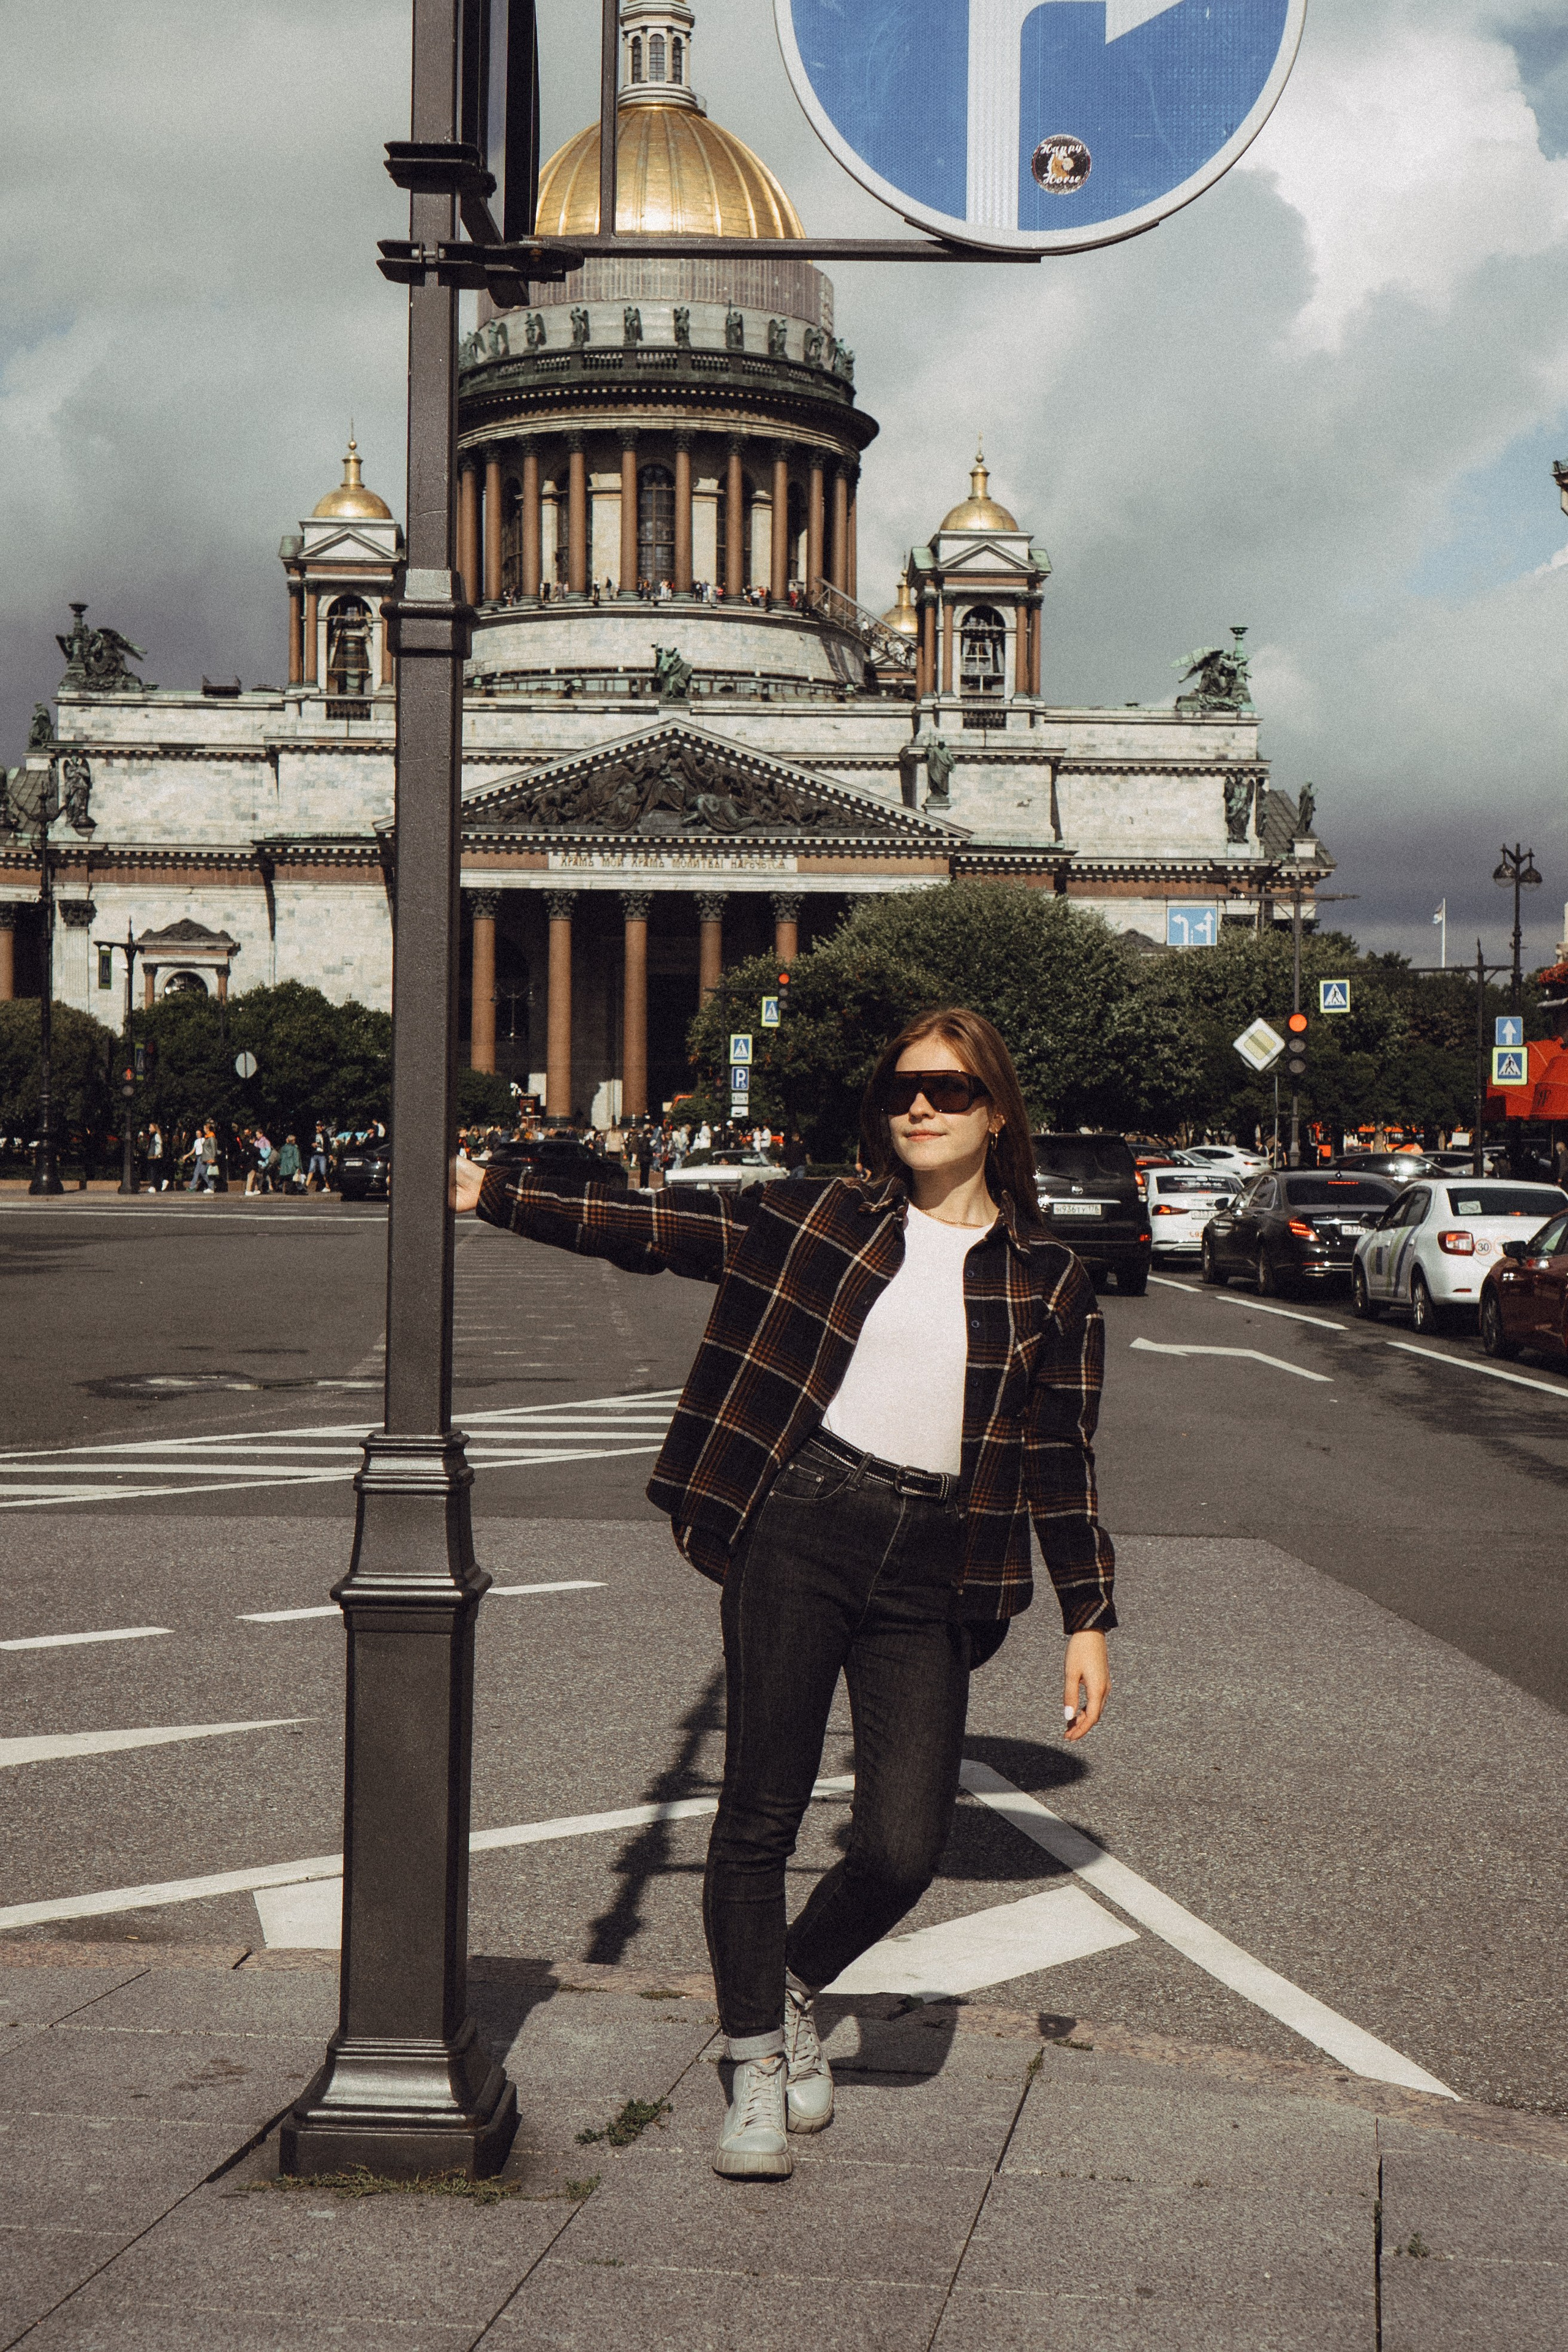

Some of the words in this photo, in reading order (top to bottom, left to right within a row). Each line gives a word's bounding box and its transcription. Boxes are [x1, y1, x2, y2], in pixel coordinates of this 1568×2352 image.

[1040, 143, 1082, 156] Happy
[1042, 173, 1081, 184] Horse
[1478, 1243, 1490, 1251] 30
